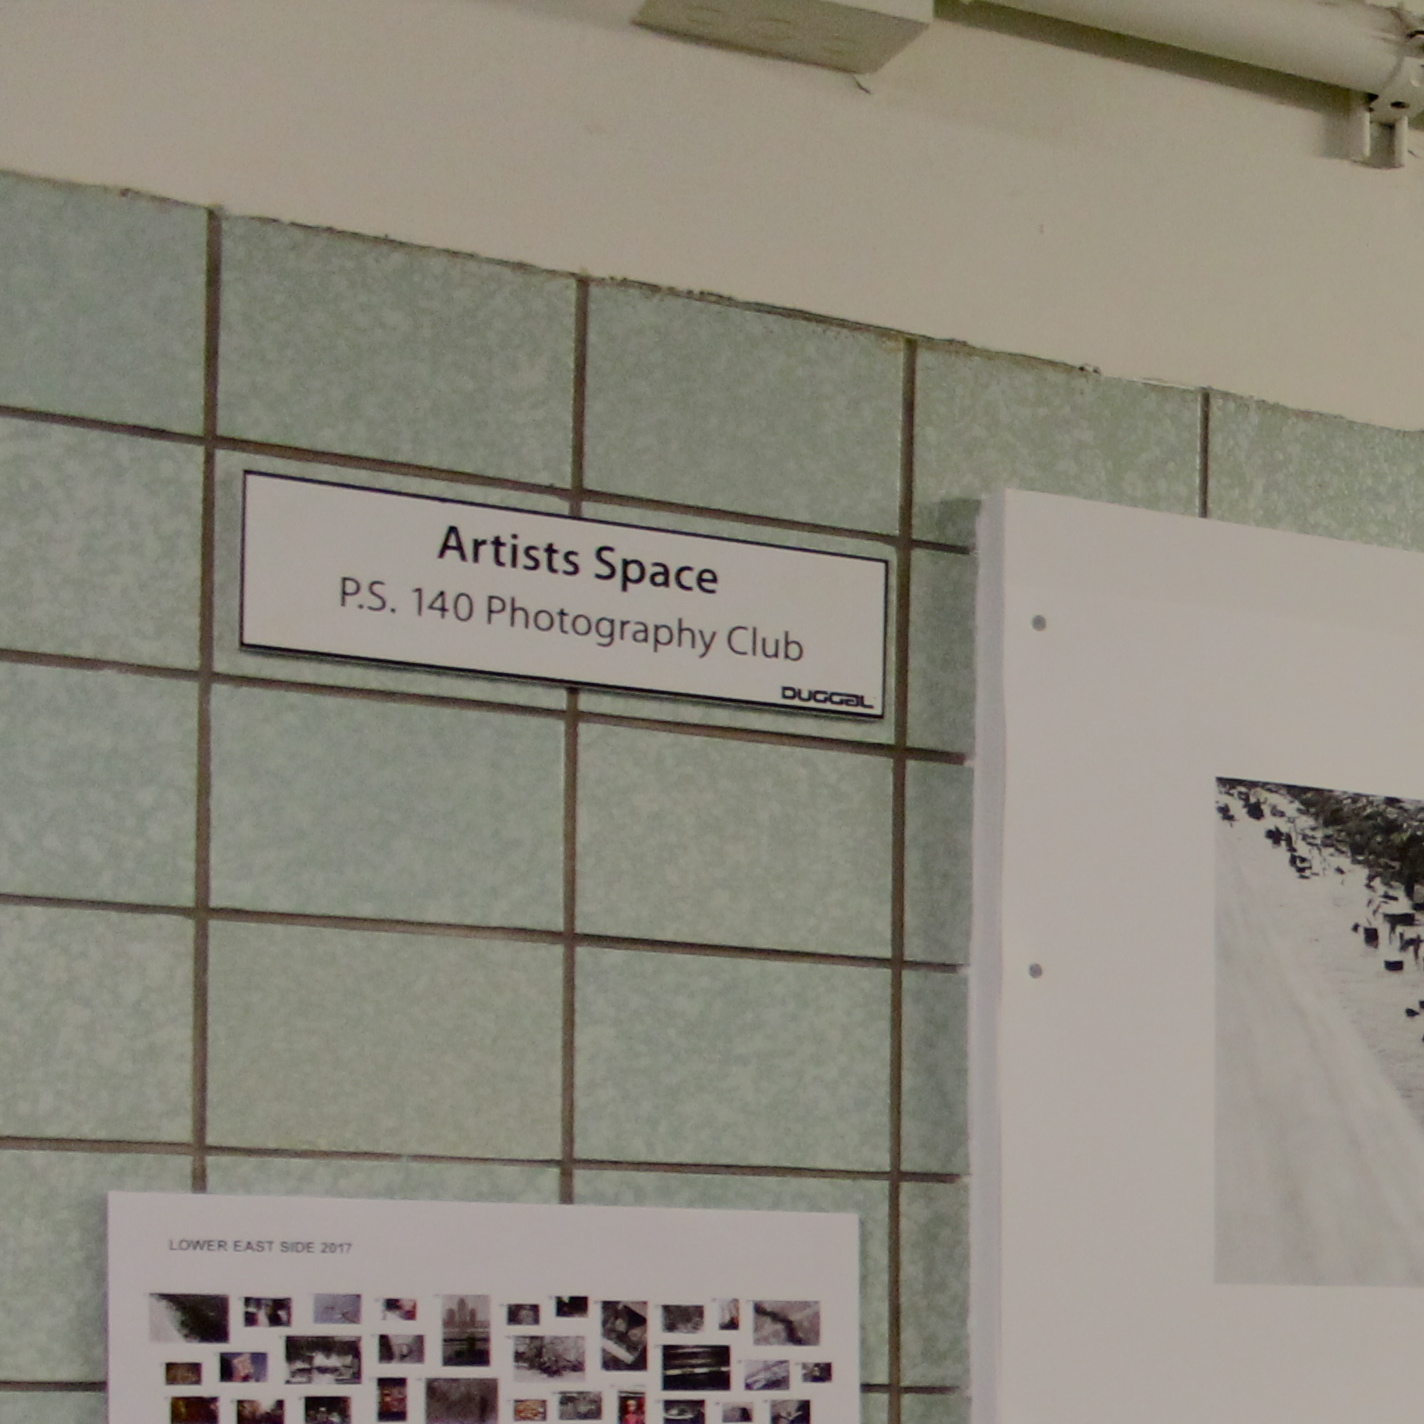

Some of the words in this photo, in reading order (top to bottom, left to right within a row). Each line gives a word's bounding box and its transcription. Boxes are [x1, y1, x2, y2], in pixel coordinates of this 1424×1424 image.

[438, 525, 580, 576] Artists
[594, 546, 718, 594] Space
[339, 576, 397, 615] P.S.
[412, 587, 474, 622] 140
[487, 596, 717, 657] Photography
[727, 625, 804, 662] Club
[168, 1238, 228, 1252] LOWER
[233, 1239, 274, 1253] EAST
[280, 1240, 315, 1254] SIDE
[320, 1241, 353, 1255] 2017
